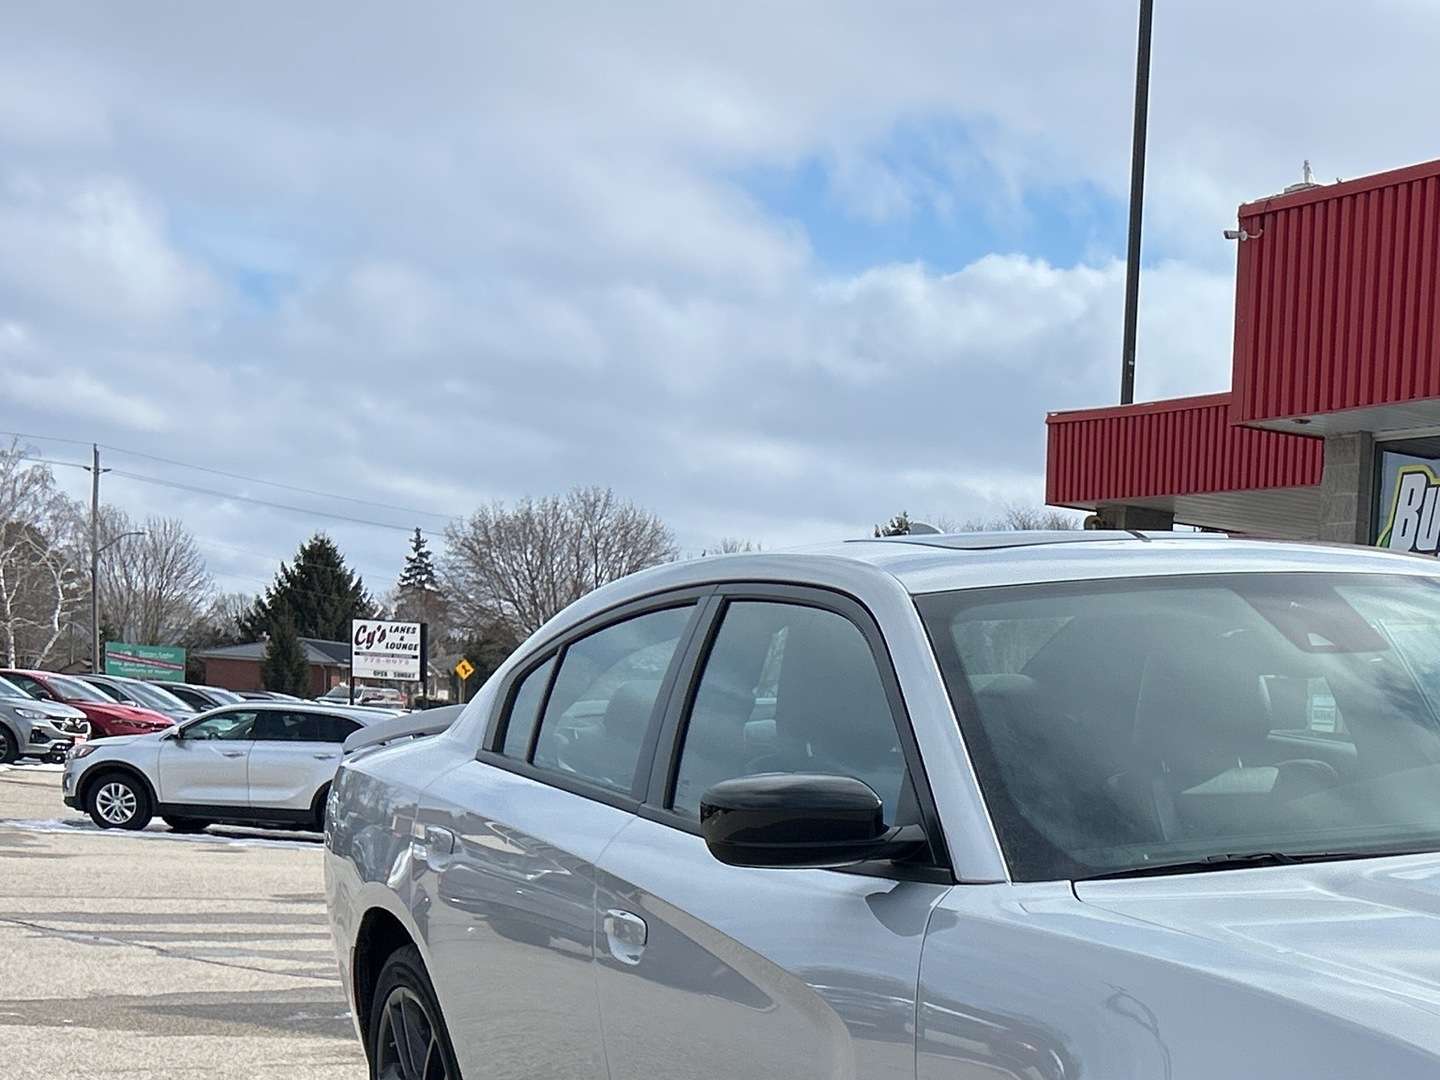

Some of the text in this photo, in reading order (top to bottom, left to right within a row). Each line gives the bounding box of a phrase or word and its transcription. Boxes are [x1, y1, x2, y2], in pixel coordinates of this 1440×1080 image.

[389, 625, 417, 635] LANES
[354, 624, 387, 650] Cy's
[385, 642, 419, 652] LOUNGE
